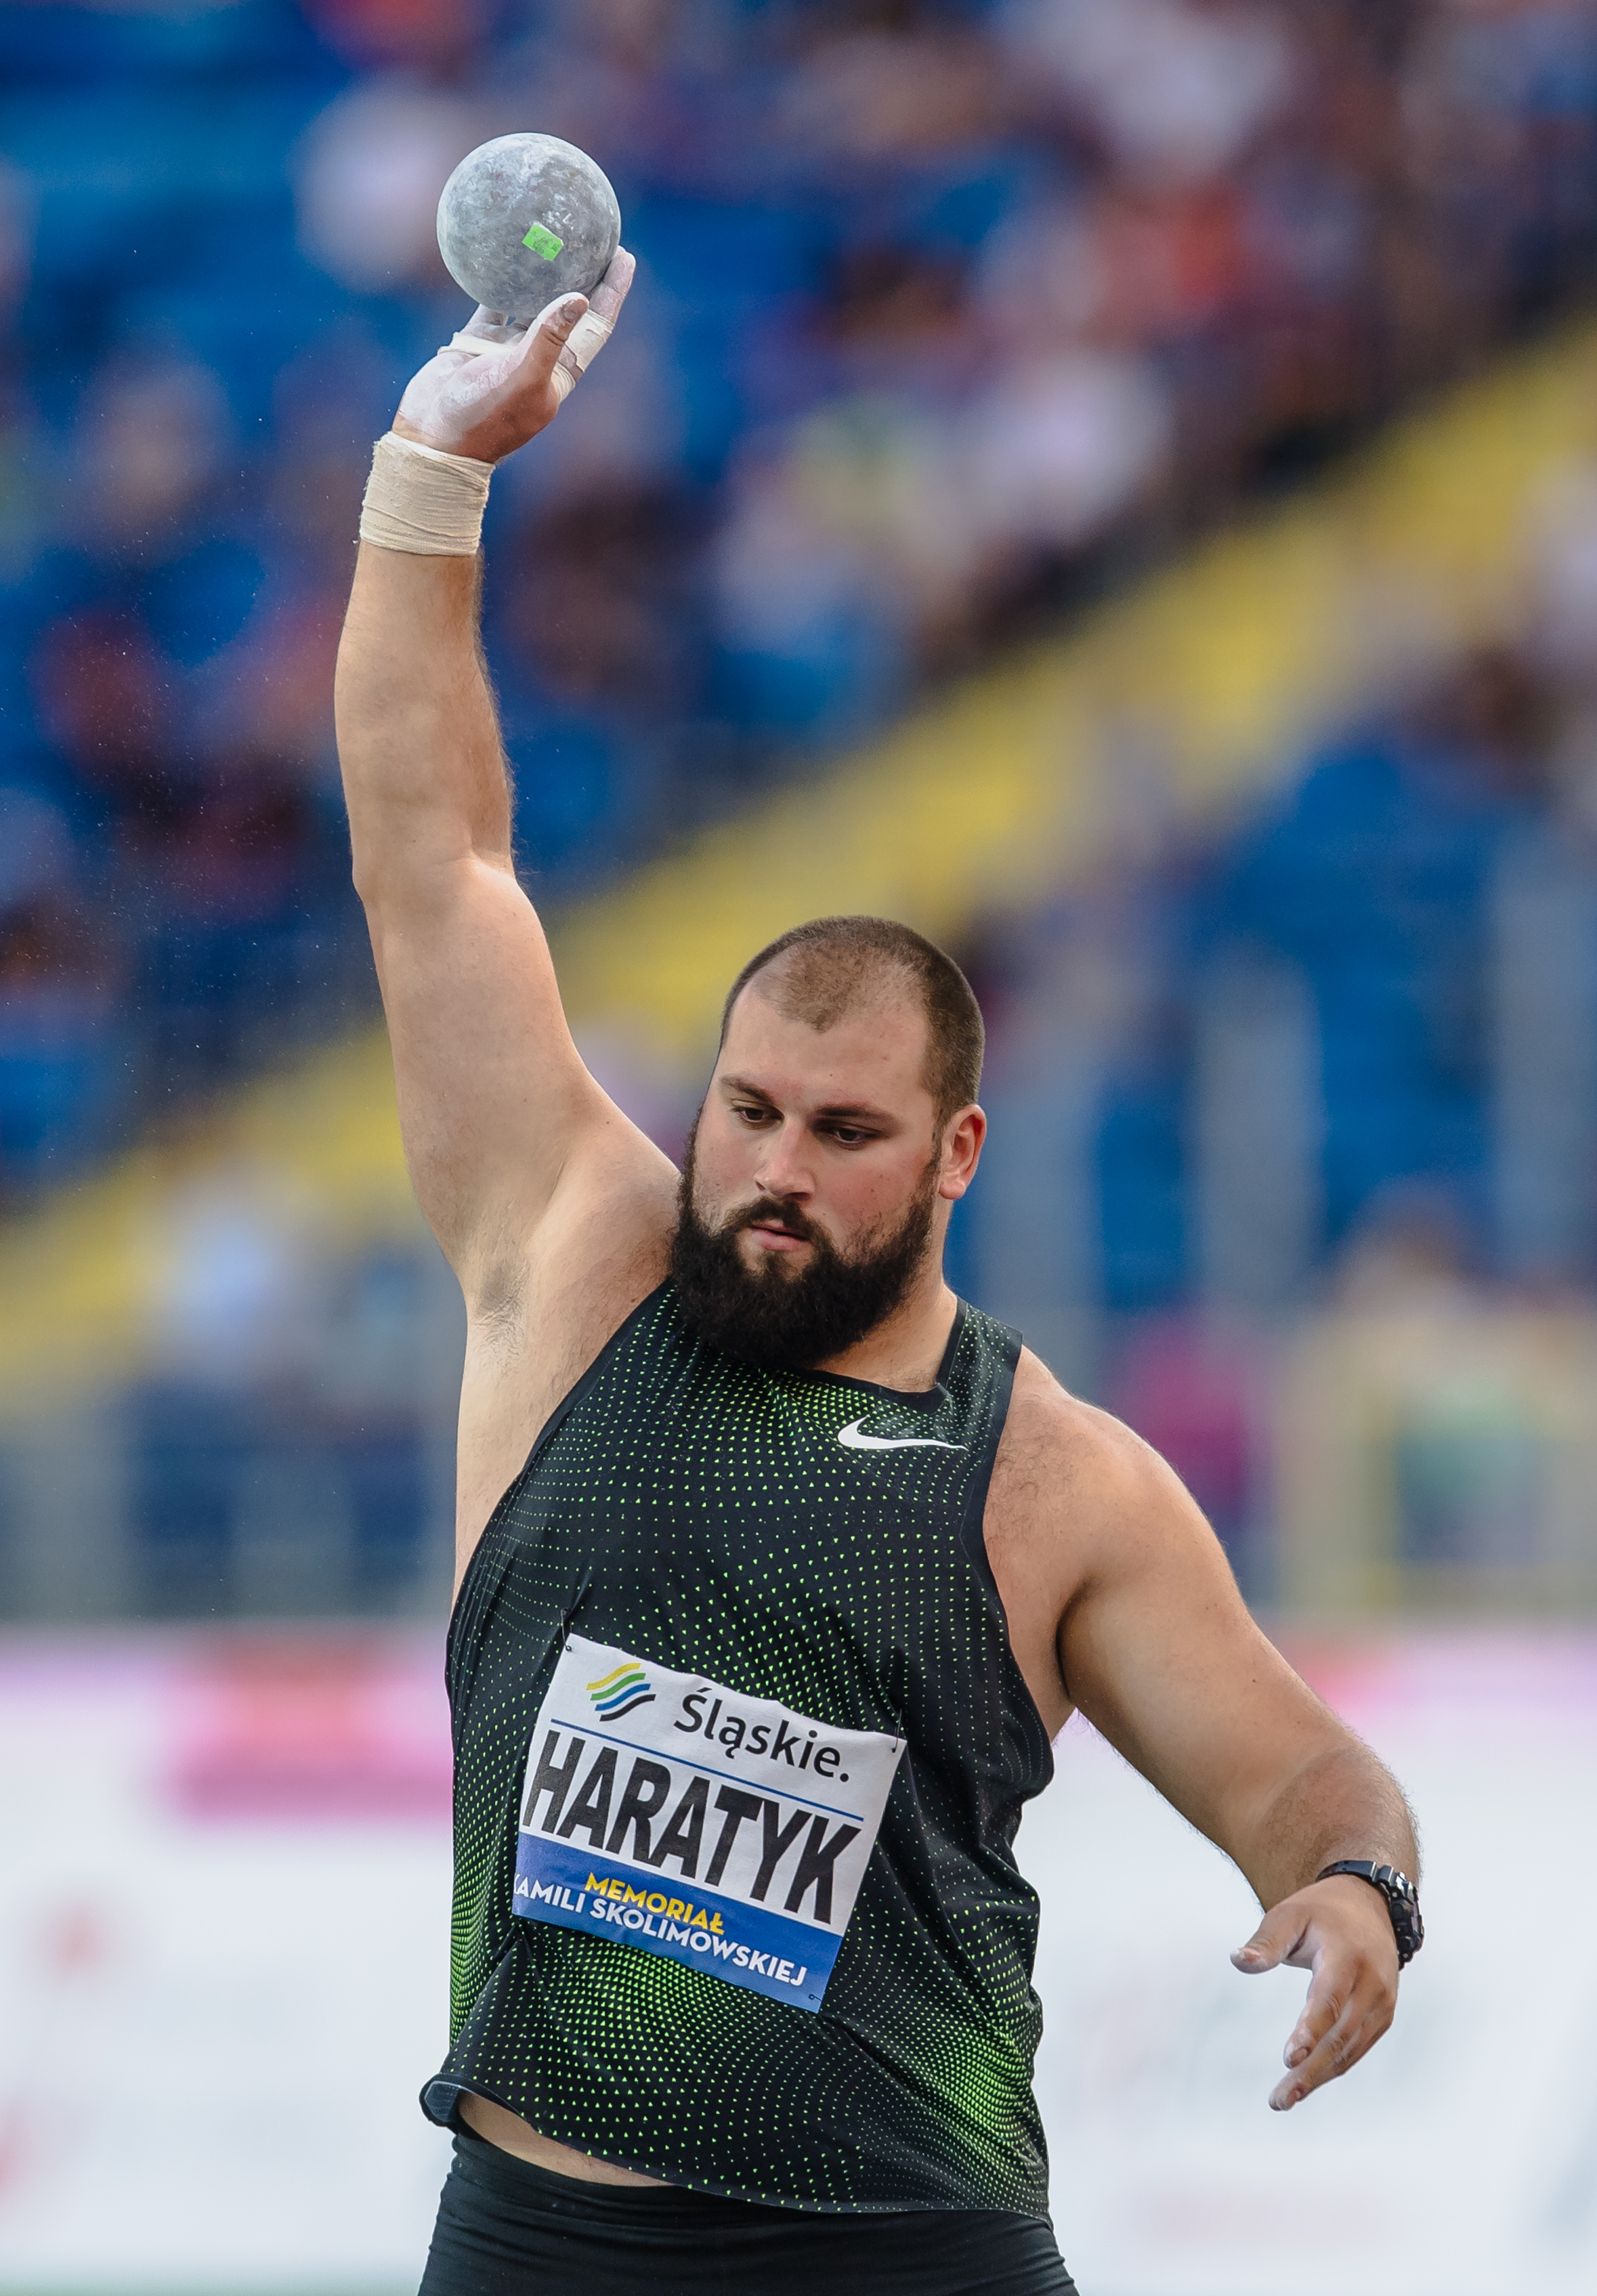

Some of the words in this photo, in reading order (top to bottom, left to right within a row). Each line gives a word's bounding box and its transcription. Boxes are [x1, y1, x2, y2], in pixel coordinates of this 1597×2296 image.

[673, 1687, 849, 1782] Śląskie.
[522, 1729, 861, 1924] HARATYK
[584, 1872, 724, 1935] MEMORIAŁ
[590, 1899, 807, 1986] SKOLIMOWSKIEJ
